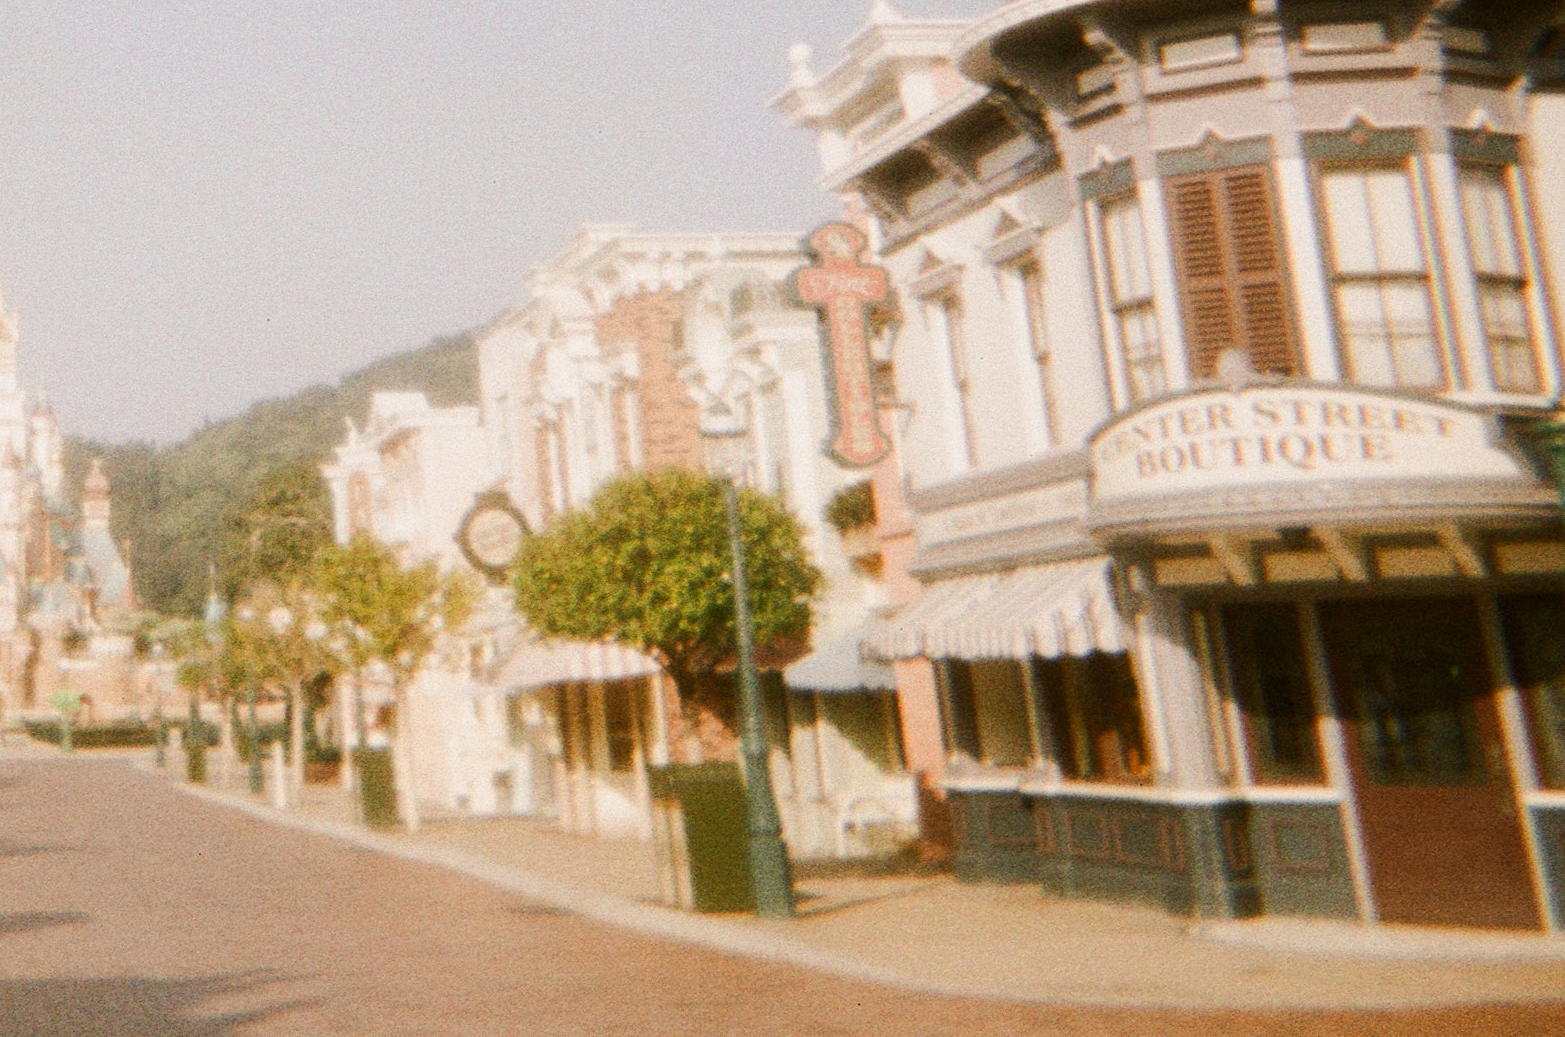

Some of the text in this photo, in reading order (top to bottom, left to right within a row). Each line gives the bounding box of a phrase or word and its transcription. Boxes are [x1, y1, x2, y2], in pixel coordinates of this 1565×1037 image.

[1100, 398, 1455, 463] CENTER STREET
[1135, 432, 1394, 479] BOUTIQUE
